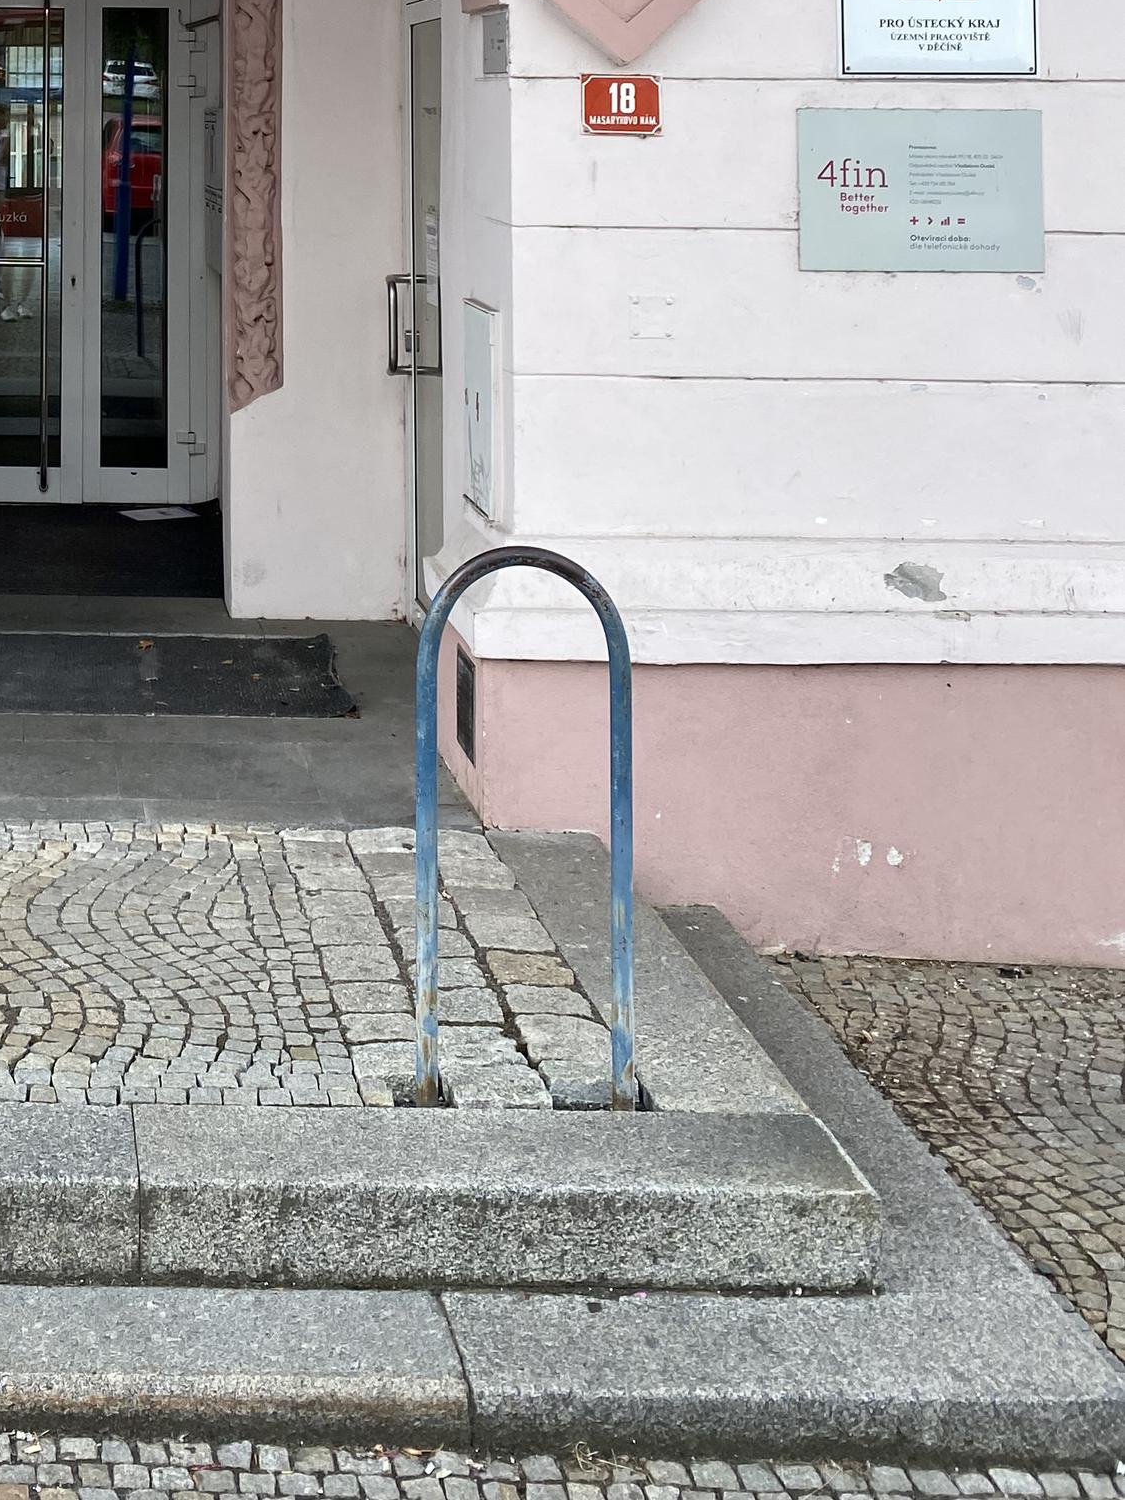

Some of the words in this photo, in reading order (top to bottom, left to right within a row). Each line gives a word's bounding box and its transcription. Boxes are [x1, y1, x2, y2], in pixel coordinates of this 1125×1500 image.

[879, 18, 904, 28] PRO
[908, 16, 964, 28] ÚSTECKÝ
[968, 19, 1001, 28] KRAJ
[890, 32, 928, 41] ÚZEMNÍ
[930, 32, 991, 41] PRACOVIŠTĚ
[918, 43, 925, 51] V
[927, 42, 963, 51] DĚČÍNĚ
[608, 82, 636, 114] 18
[589, 115, 638, 125] MASARYKOVO
[640, 114, 658, 125] NÁM.
[817, 158, 888, 188] 4fin
[840, 192, 875, 202] Better
[841, 203, 889, 215] together
[910, 242, 922, 250] dle
[970, 243, 1000, 252] dohody
